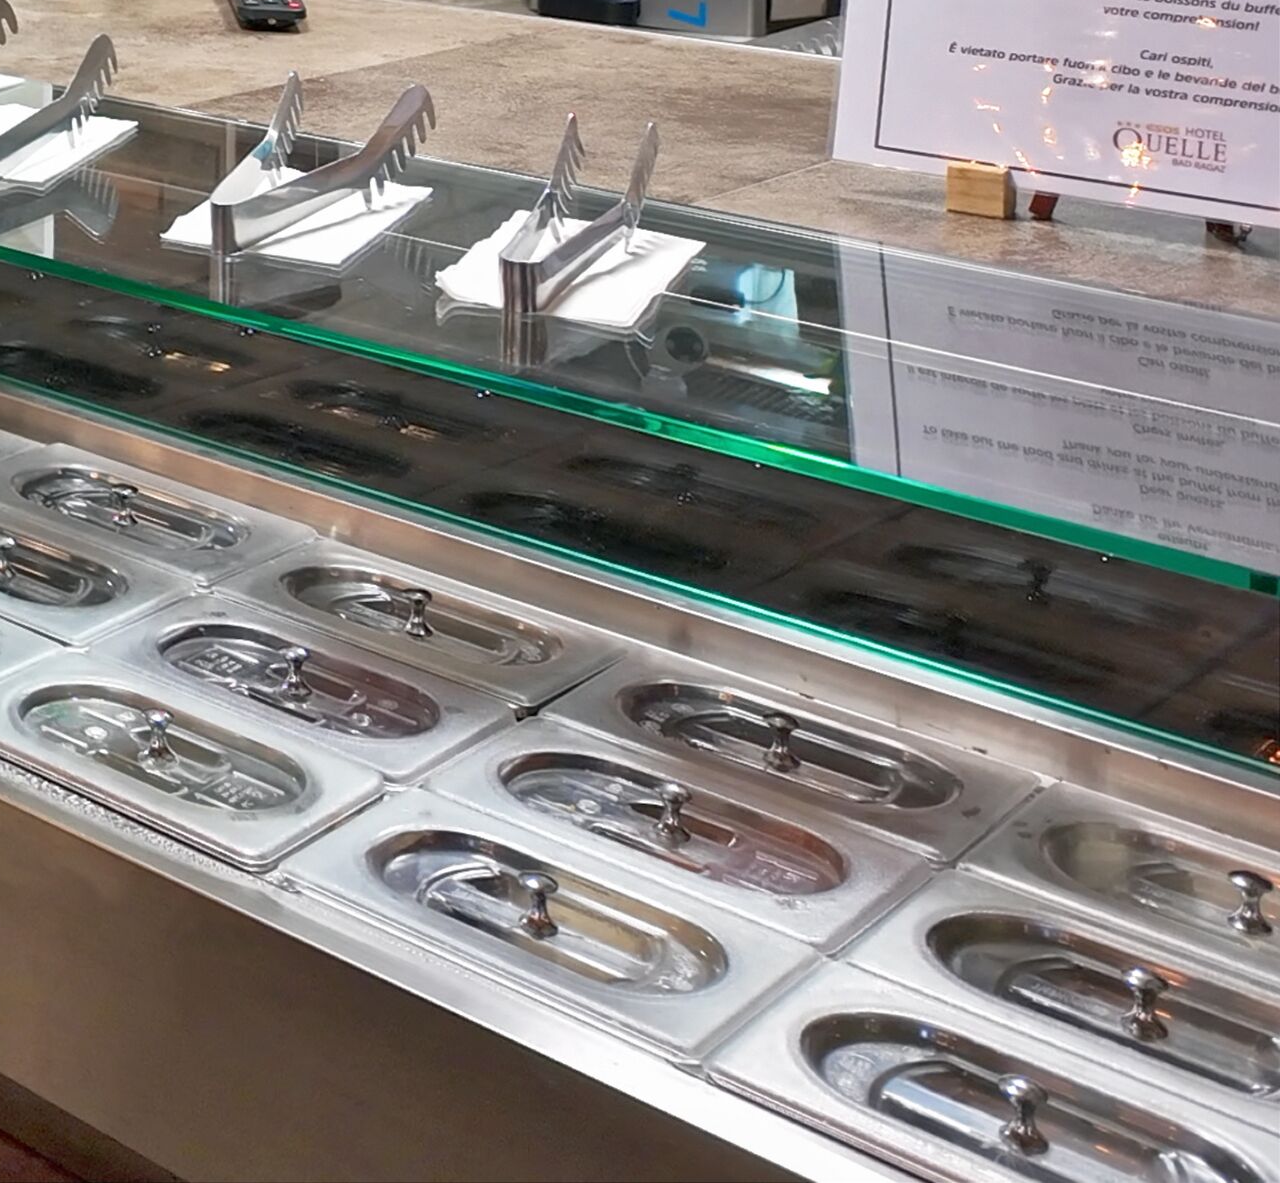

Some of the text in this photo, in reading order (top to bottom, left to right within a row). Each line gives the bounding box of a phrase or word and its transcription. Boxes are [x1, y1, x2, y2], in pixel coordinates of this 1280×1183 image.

[1221, 0, 1241, 12] du
[1103, 5, 1260, 32] votre comprension!
[1140, 49, 1167, 62] Cari
[960, 45, 1006, 59] vietato
[1009, 52, 1059, 67] portare
[1111, 64, 1140, 76] cibo
[1144, 70, 1154, 79] e
[1158, 69, 1171, 80] le
[1174, 72, 1237, 90] bevande
[1241, 80, 1266, 93] del
[1128, 83, 1140, 94] la
[1145, 87, 1189, 101] vostra
[1185, 126, 1227, 142] HOTEL
[1112, 127, 1228, 164] QUELLE
